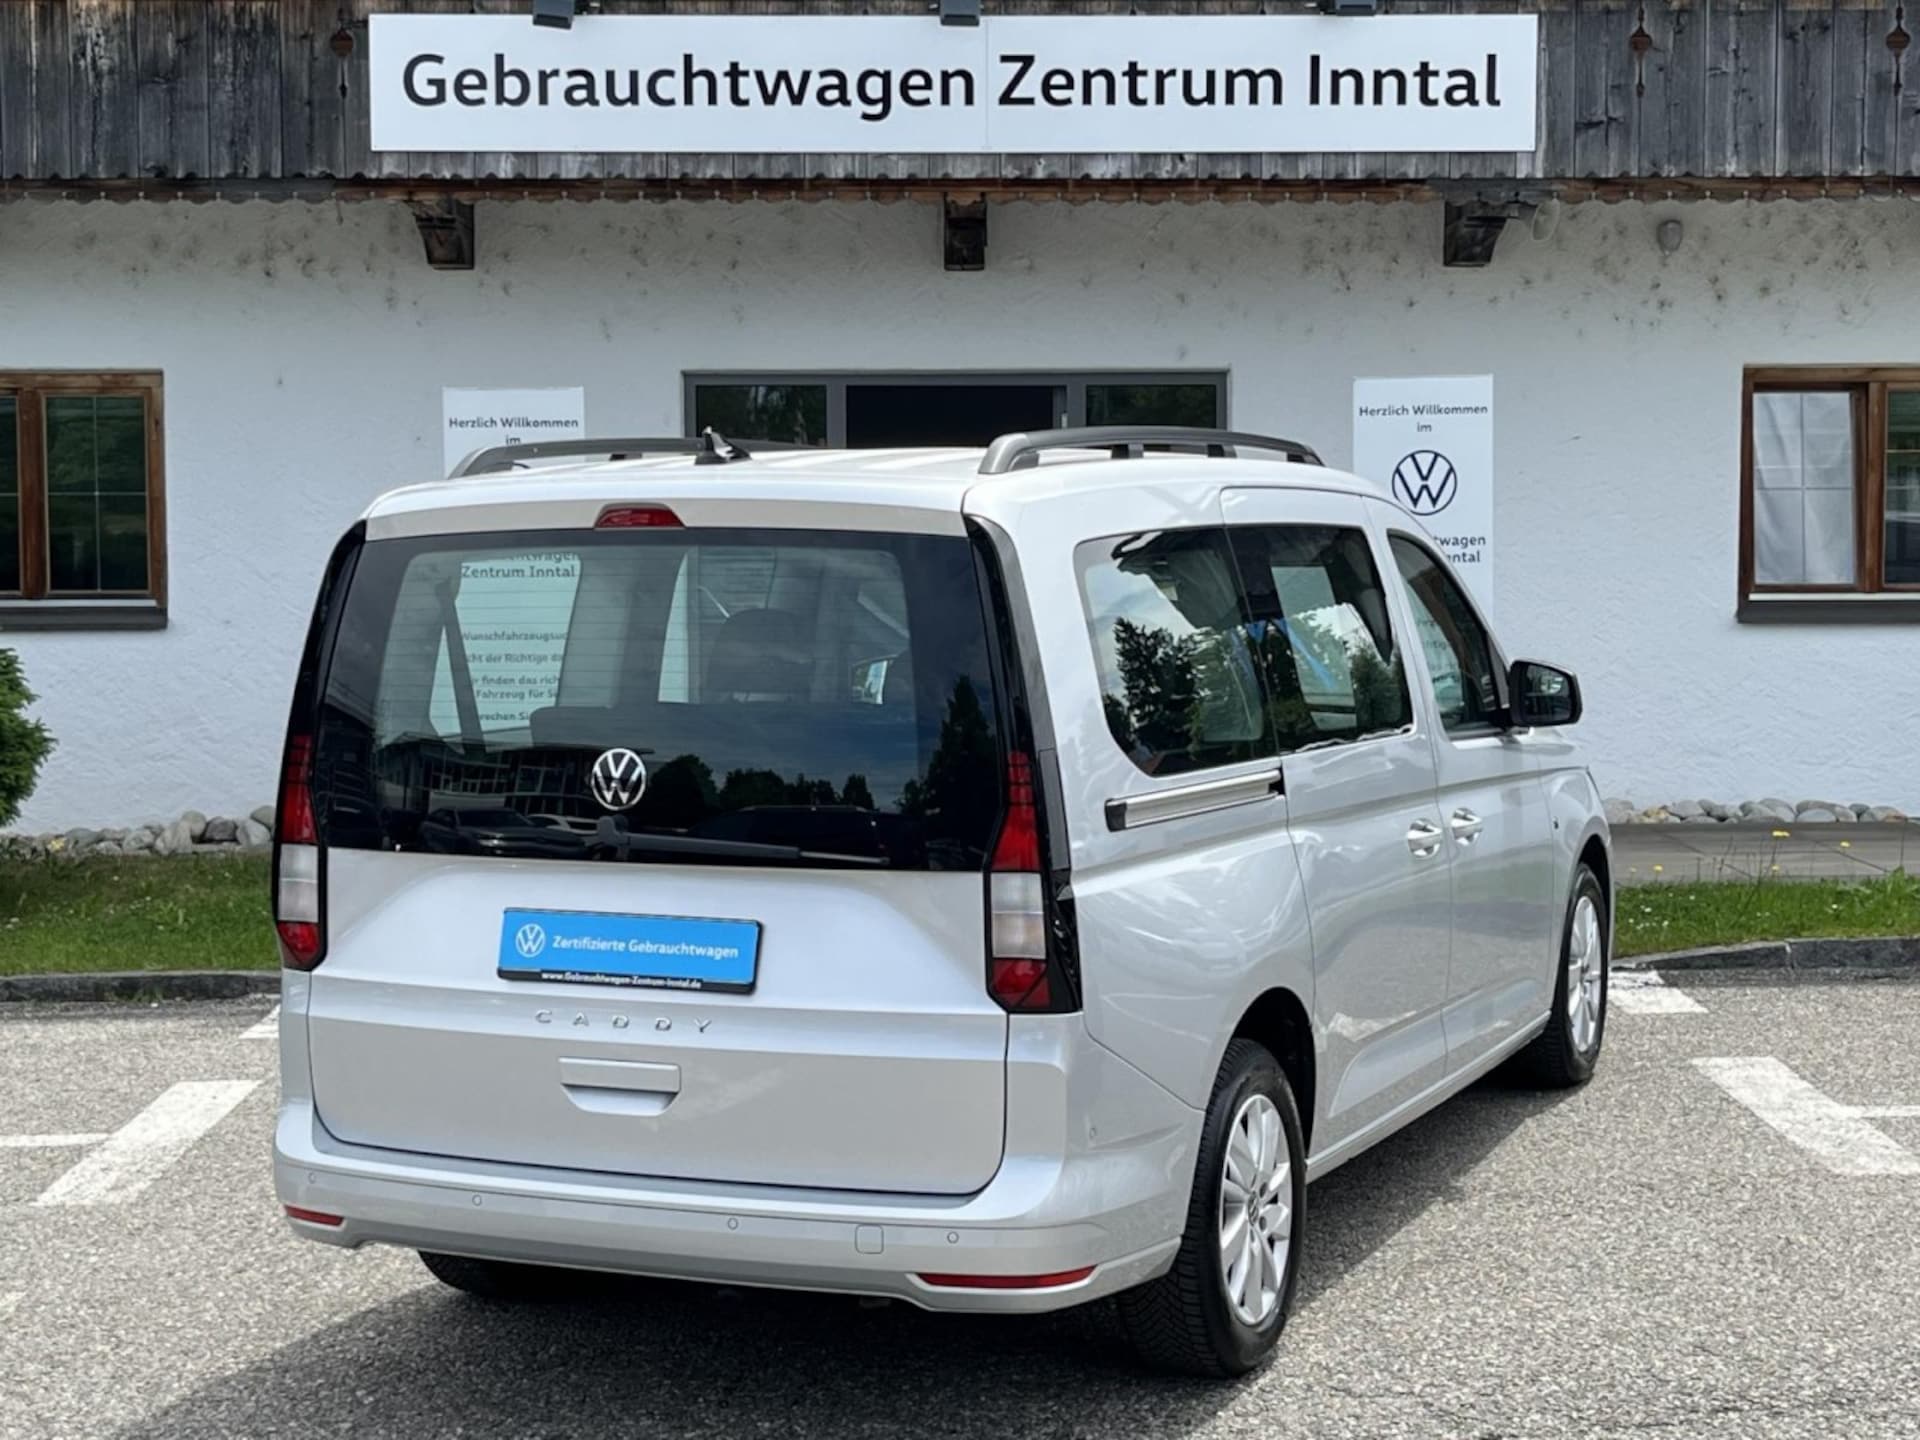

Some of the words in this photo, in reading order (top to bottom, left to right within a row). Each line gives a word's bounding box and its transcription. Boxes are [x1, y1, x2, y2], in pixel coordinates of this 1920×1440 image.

[402, 53, 975, 121] Gebrauchtwagen
[999, 54, 1283, 106] Zentrum
[1309, 54, 1500, 107] Inntal
[1359, 405, 1409, 417] Herzlich
[1412, 404, 1488, 415] Willkommen
[449, 416, 497, 428] Herzlich
[500, 416, 578, 428] Willkommen
[1417, 422, 1432, 432] im
[505, 434, 521, 446] im
[462, 565, 525, 577] Zentrum
[529, 564, 575, 577] Inntal
[504, 653, 548, 664] Richtige
[481, 674, 515, 684] finden
[518, 674, 538, 684] das
[476, 689, 525, 700] Fahrzeug
[528, 688, 544, 698] für
[552, 935, 626, 952] Zertifizierte
[628, 938, 739, 961] Gebrauchtwagen
[535, 1008, 713, 1033] CADDY
